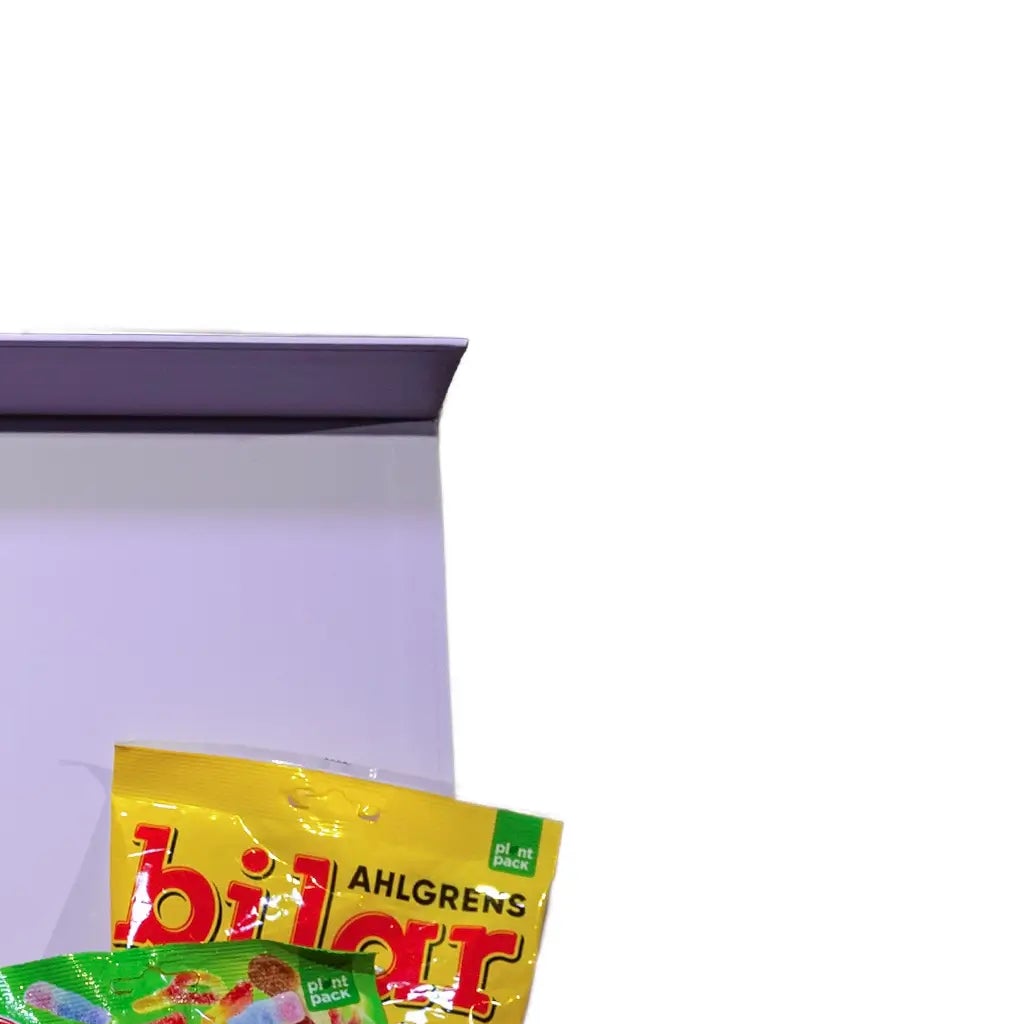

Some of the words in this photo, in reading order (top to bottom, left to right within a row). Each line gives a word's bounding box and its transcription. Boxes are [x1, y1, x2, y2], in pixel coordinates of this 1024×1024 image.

[495, 842, 533, 860] plnt
[493, 855, 529, 871] pack
[347, 865, 526, 918] AHLGRENS
[114, 823, 523, 1020] bilar
[307, 974, 349, 994] plnt
[309, 988, 352, 1008] pack
